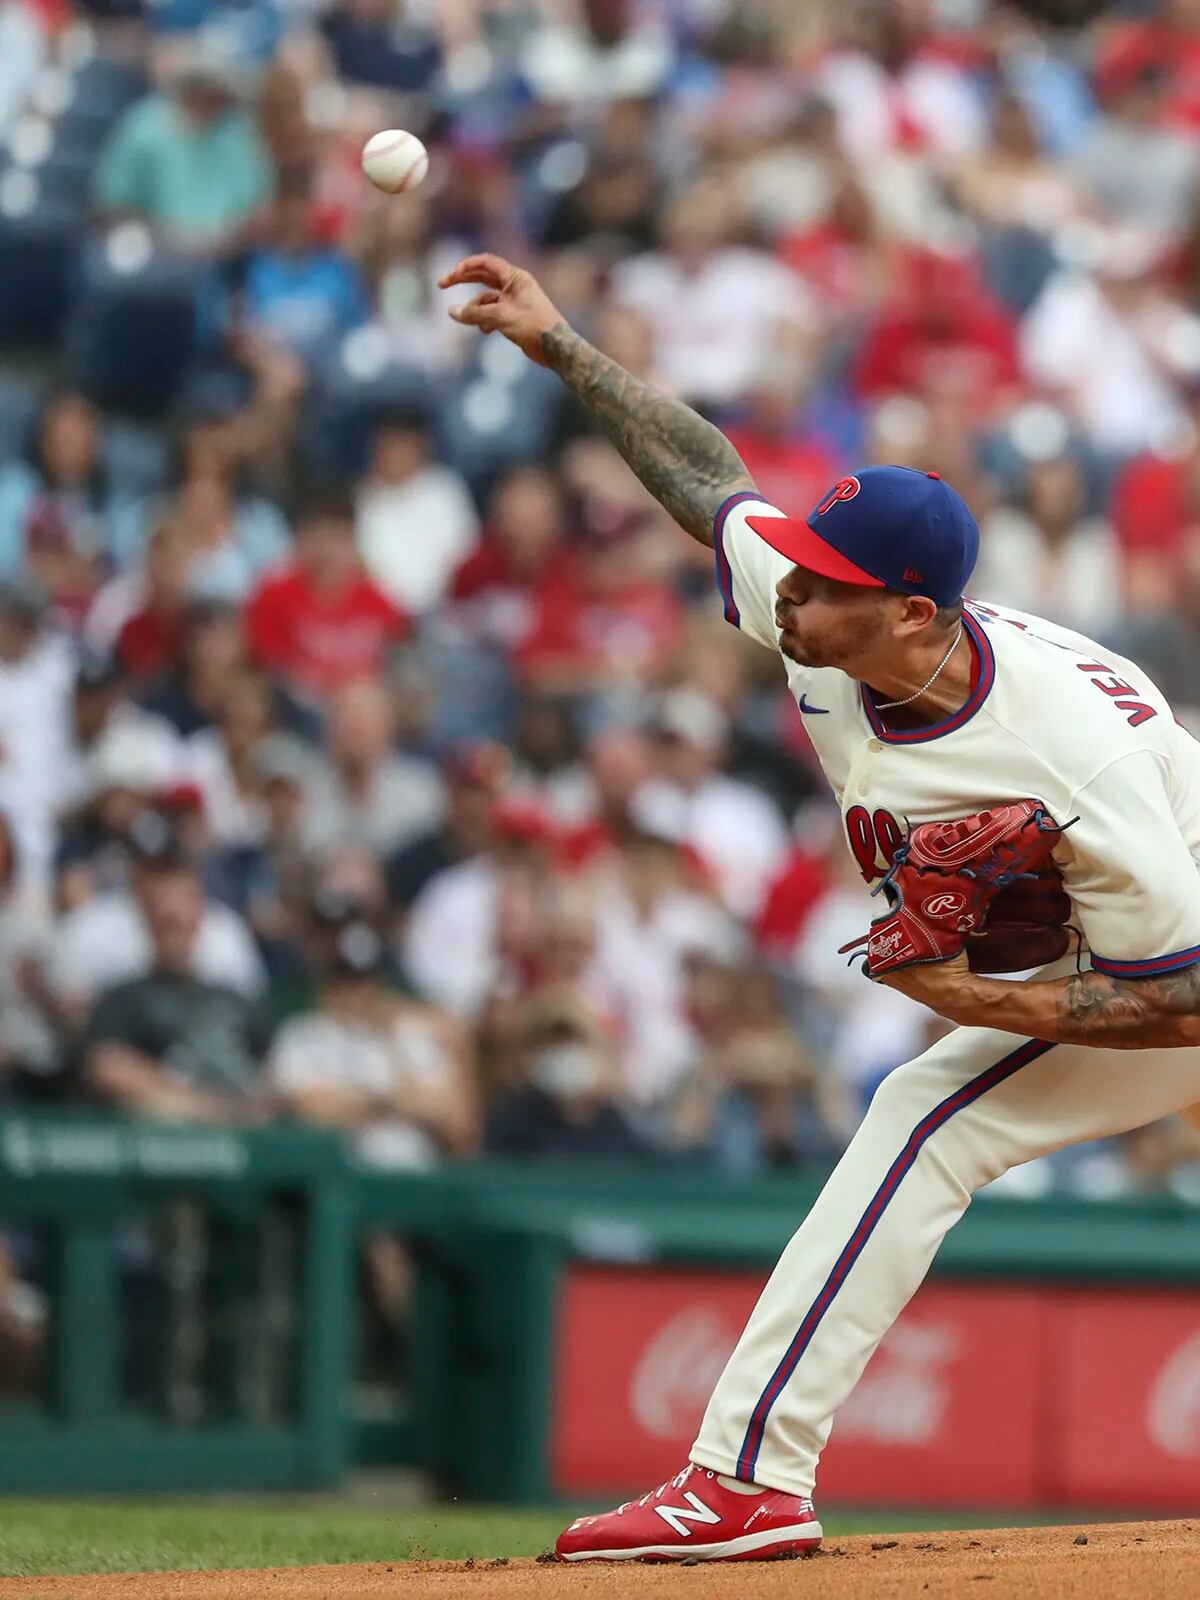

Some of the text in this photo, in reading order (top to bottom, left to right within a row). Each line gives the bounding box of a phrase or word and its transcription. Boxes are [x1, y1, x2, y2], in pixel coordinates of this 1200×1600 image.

[818, 475, 861, 516] P
[927, 895, 958, 914] R
[654, 1491, 722, 1537] N
